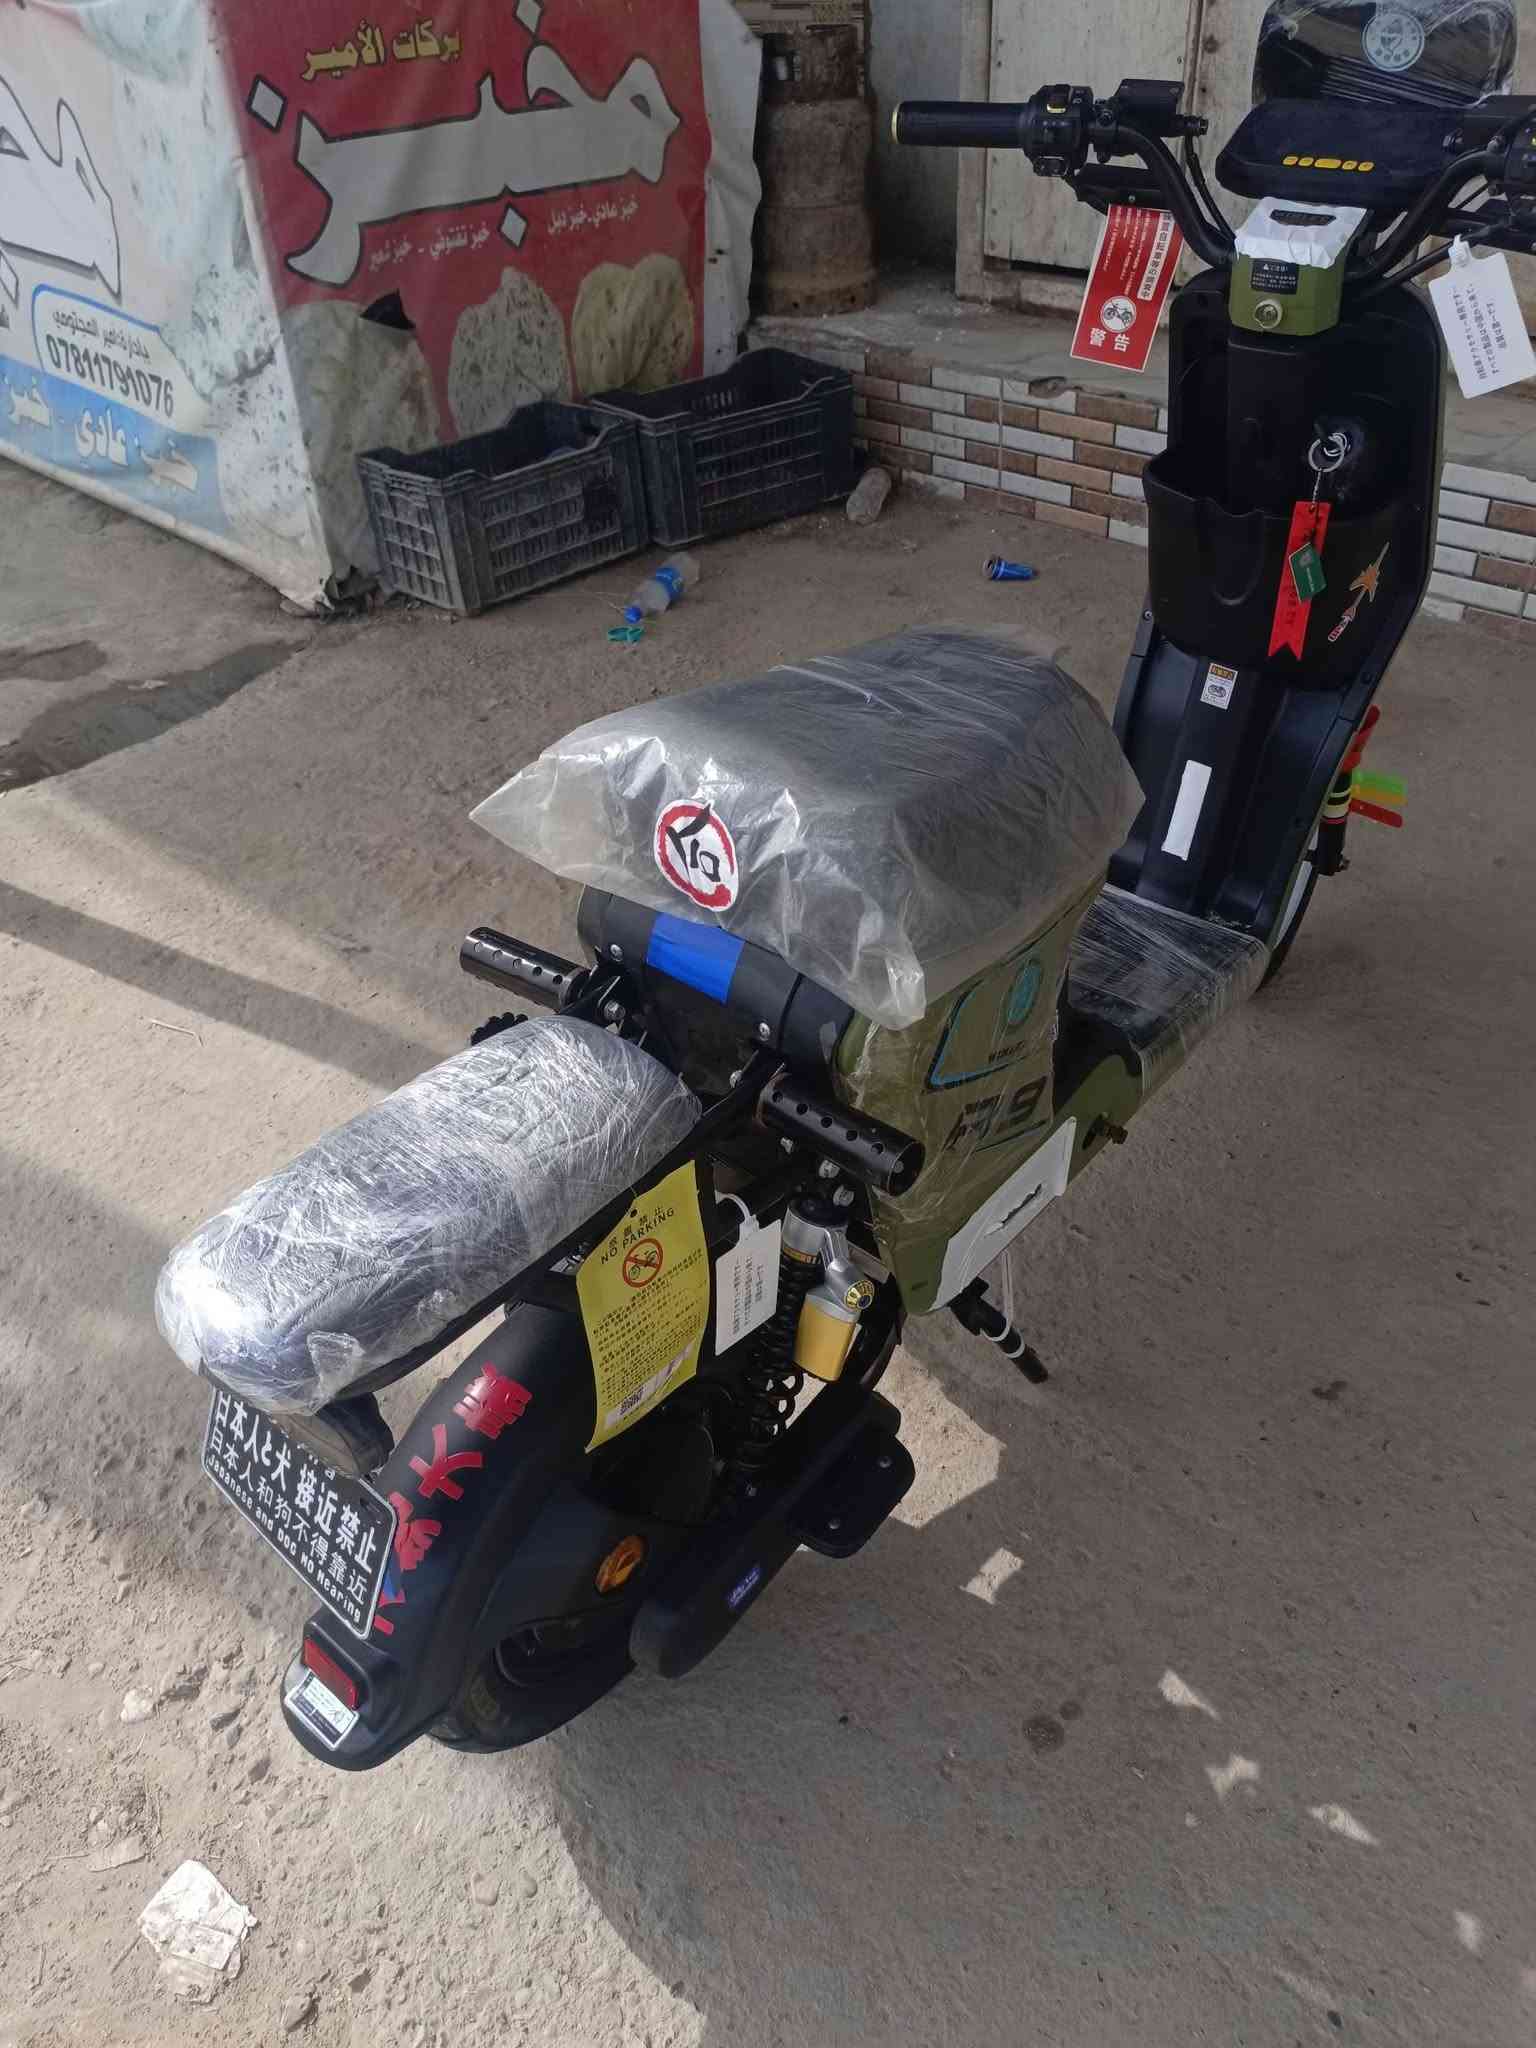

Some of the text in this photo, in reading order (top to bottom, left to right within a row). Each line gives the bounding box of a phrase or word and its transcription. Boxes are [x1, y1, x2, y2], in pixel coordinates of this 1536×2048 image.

[301, 18, 460, 81] بركات الأمير
[246, 0, 681, 287] مخبز
[46, 333, 174, 419] 07811791076
[74, 404, 129, 468] عادي
[601, 1207, 675, 1264] NO PARKING
[207, 1454, 253, 1507] Japanese
[255, 1506, 273, 1531] and
[209, 1426, 368, 1606] 日本人和狗不得靠近
[214, 1391, 291, 1491] 日本人と犬
[295, 1463, 377, 1574] 接近禁止
